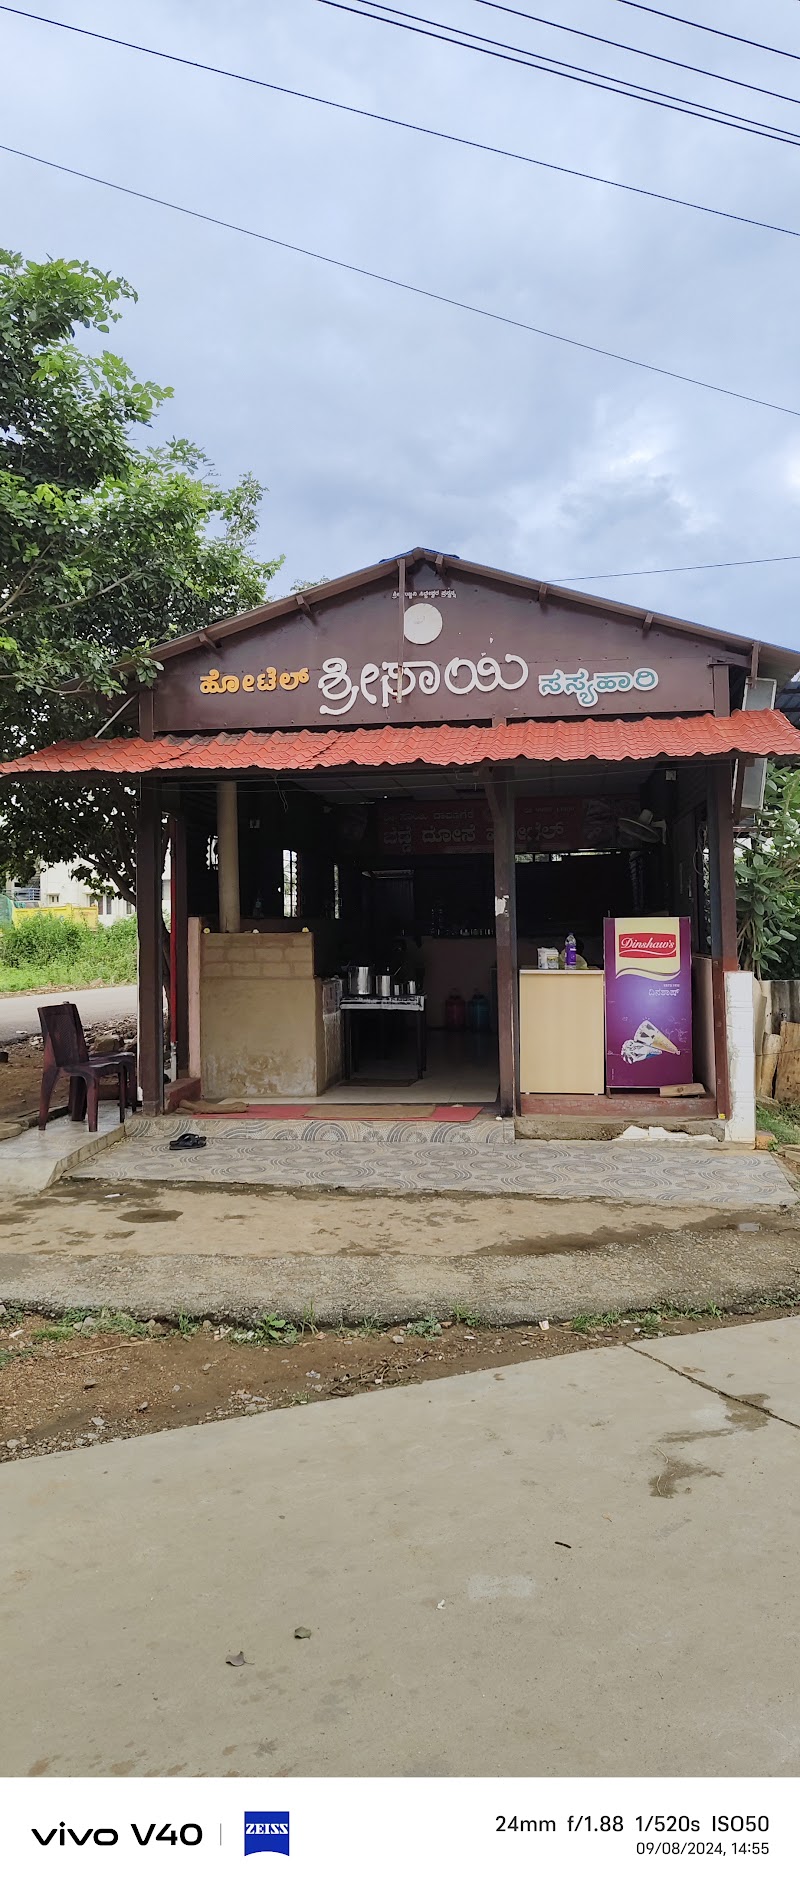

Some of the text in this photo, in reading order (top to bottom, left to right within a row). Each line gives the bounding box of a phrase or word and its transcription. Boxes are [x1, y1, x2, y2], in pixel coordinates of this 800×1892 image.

[200, 653, 659, 716] ಹೋಟೆಲ್ ಶ್ರೀಸಾಯಿ ಸಸ್ಯಹಾರಿ
[621, 937, 675, 949] Dinshaw's
